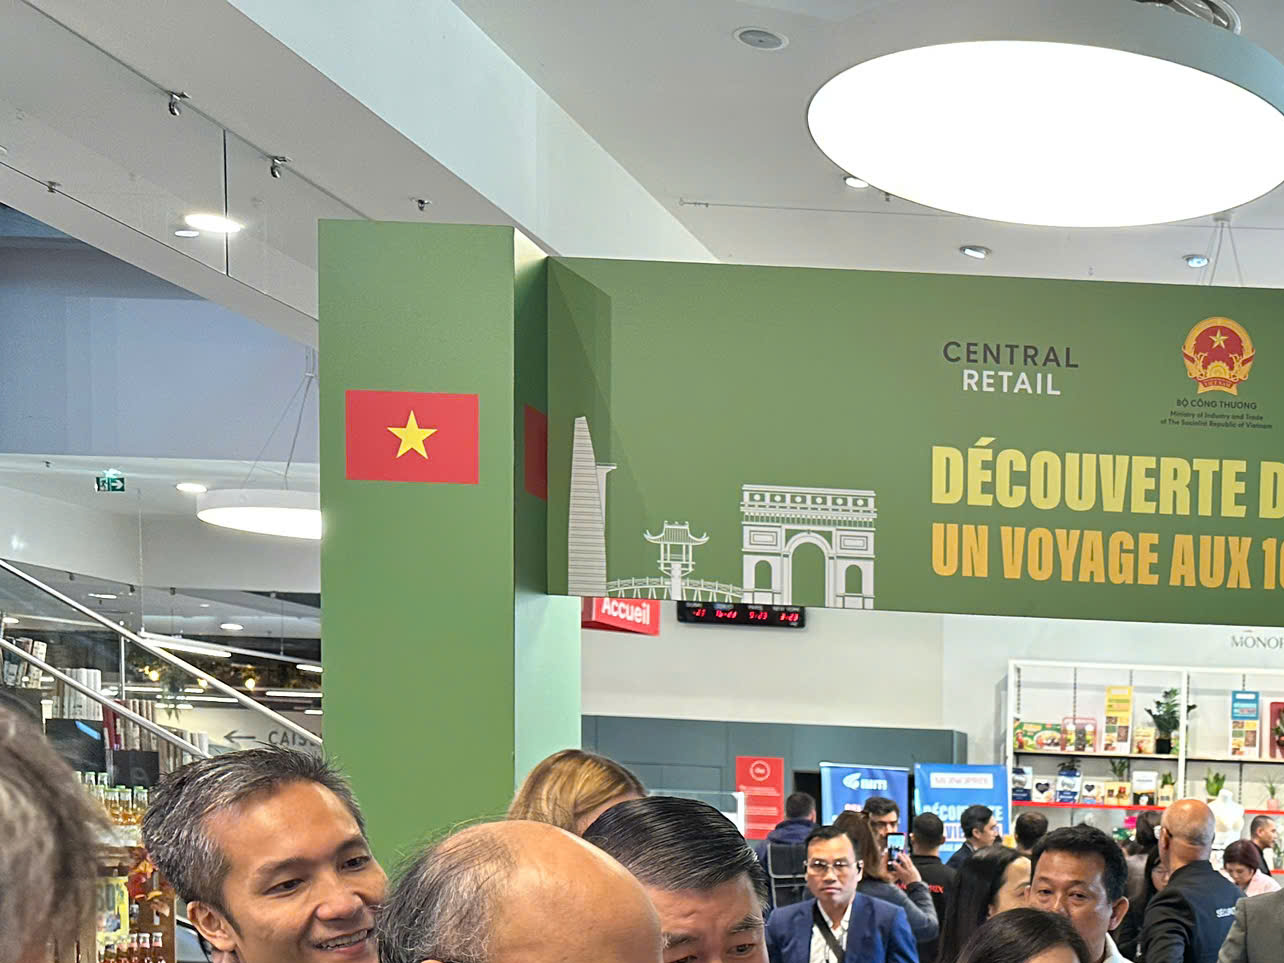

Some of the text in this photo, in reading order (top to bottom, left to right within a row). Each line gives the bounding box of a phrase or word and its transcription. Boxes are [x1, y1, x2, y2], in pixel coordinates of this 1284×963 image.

[943, 341, 1079, 369] CENTRAL
[962, 369, 1061, 396] RETAIL
[1205, 412, 1230, 420] Industry
[931, 437, 1246, 518] DÉCOUVERTE
[932, 523, 988, 577] UN
[1001, 526, 1159, 585] VOYAGE
[1170, 534, 1252, 589] AUX
[601, 598, 651, 625] Accueil
